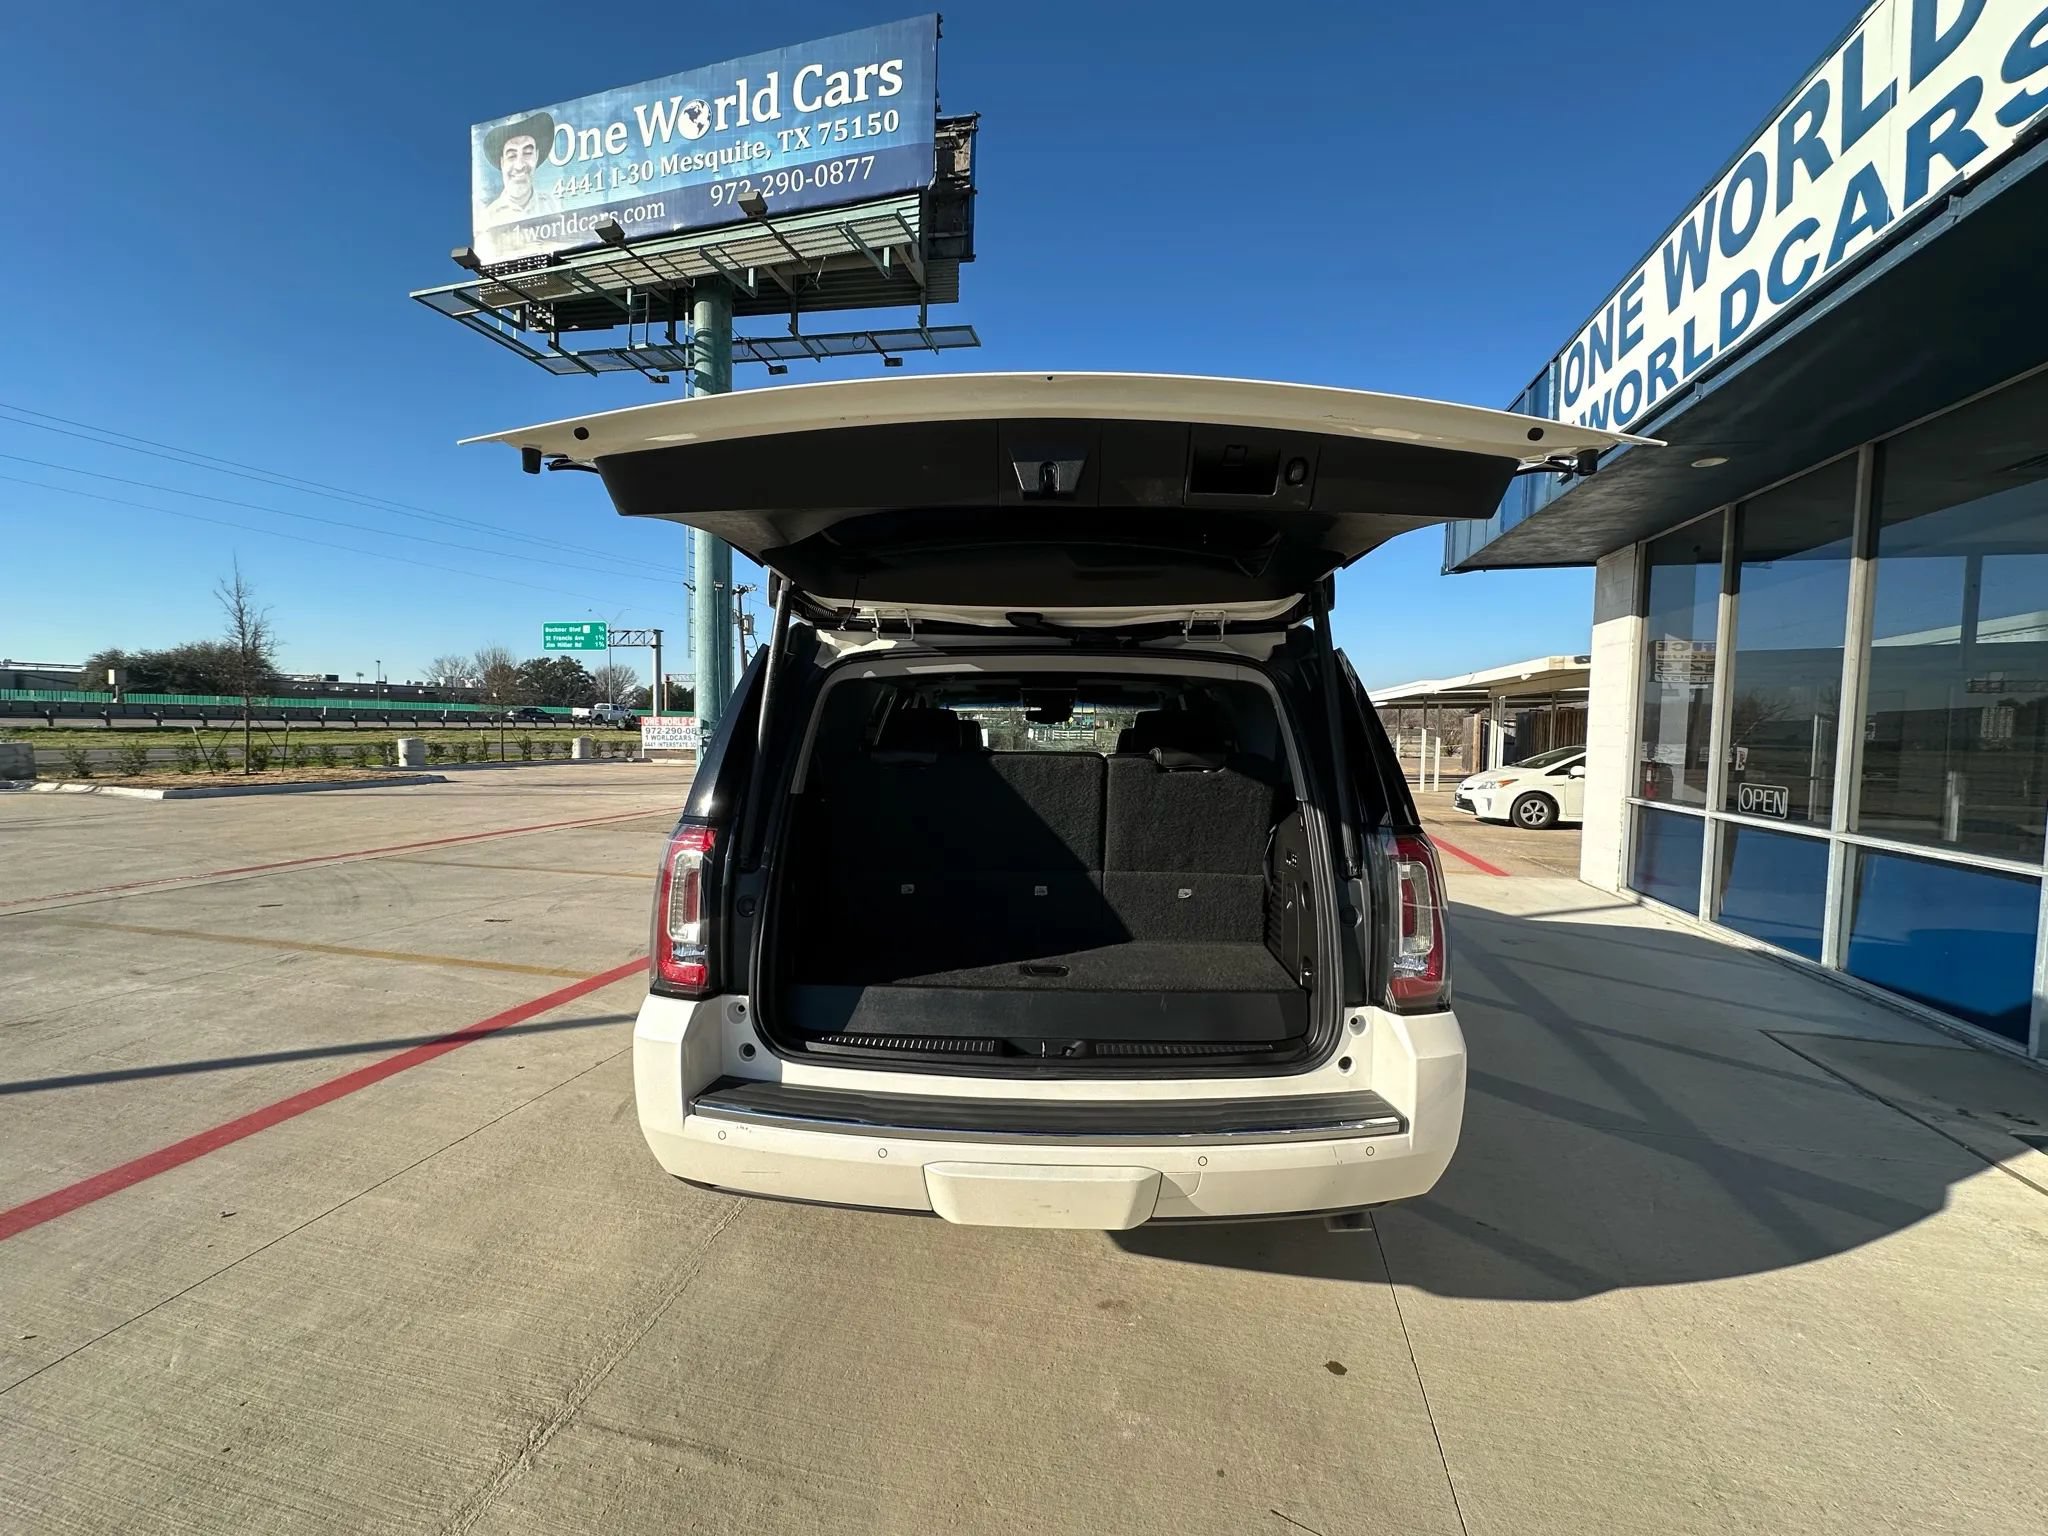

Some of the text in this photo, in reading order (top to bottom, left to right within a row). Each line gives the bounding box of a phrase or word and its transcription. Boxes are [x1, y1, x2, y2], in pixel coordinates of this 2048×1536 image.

[549, 59, 904, 167] One World Cars
[553, 109, 900, 199] 4441 I-30 Mesquite, TX 75150
[710, 155, 876, 207] 972-290-0877
[1564, 0, 1988, 408] ONE WORLD
[1572, 6, 2048, 430] WORLDCARS
[643, 717, 660, 726] ONE
[662, 717, 687, 726] WORLD
[1741, 787, 1786, 815] OPEN
